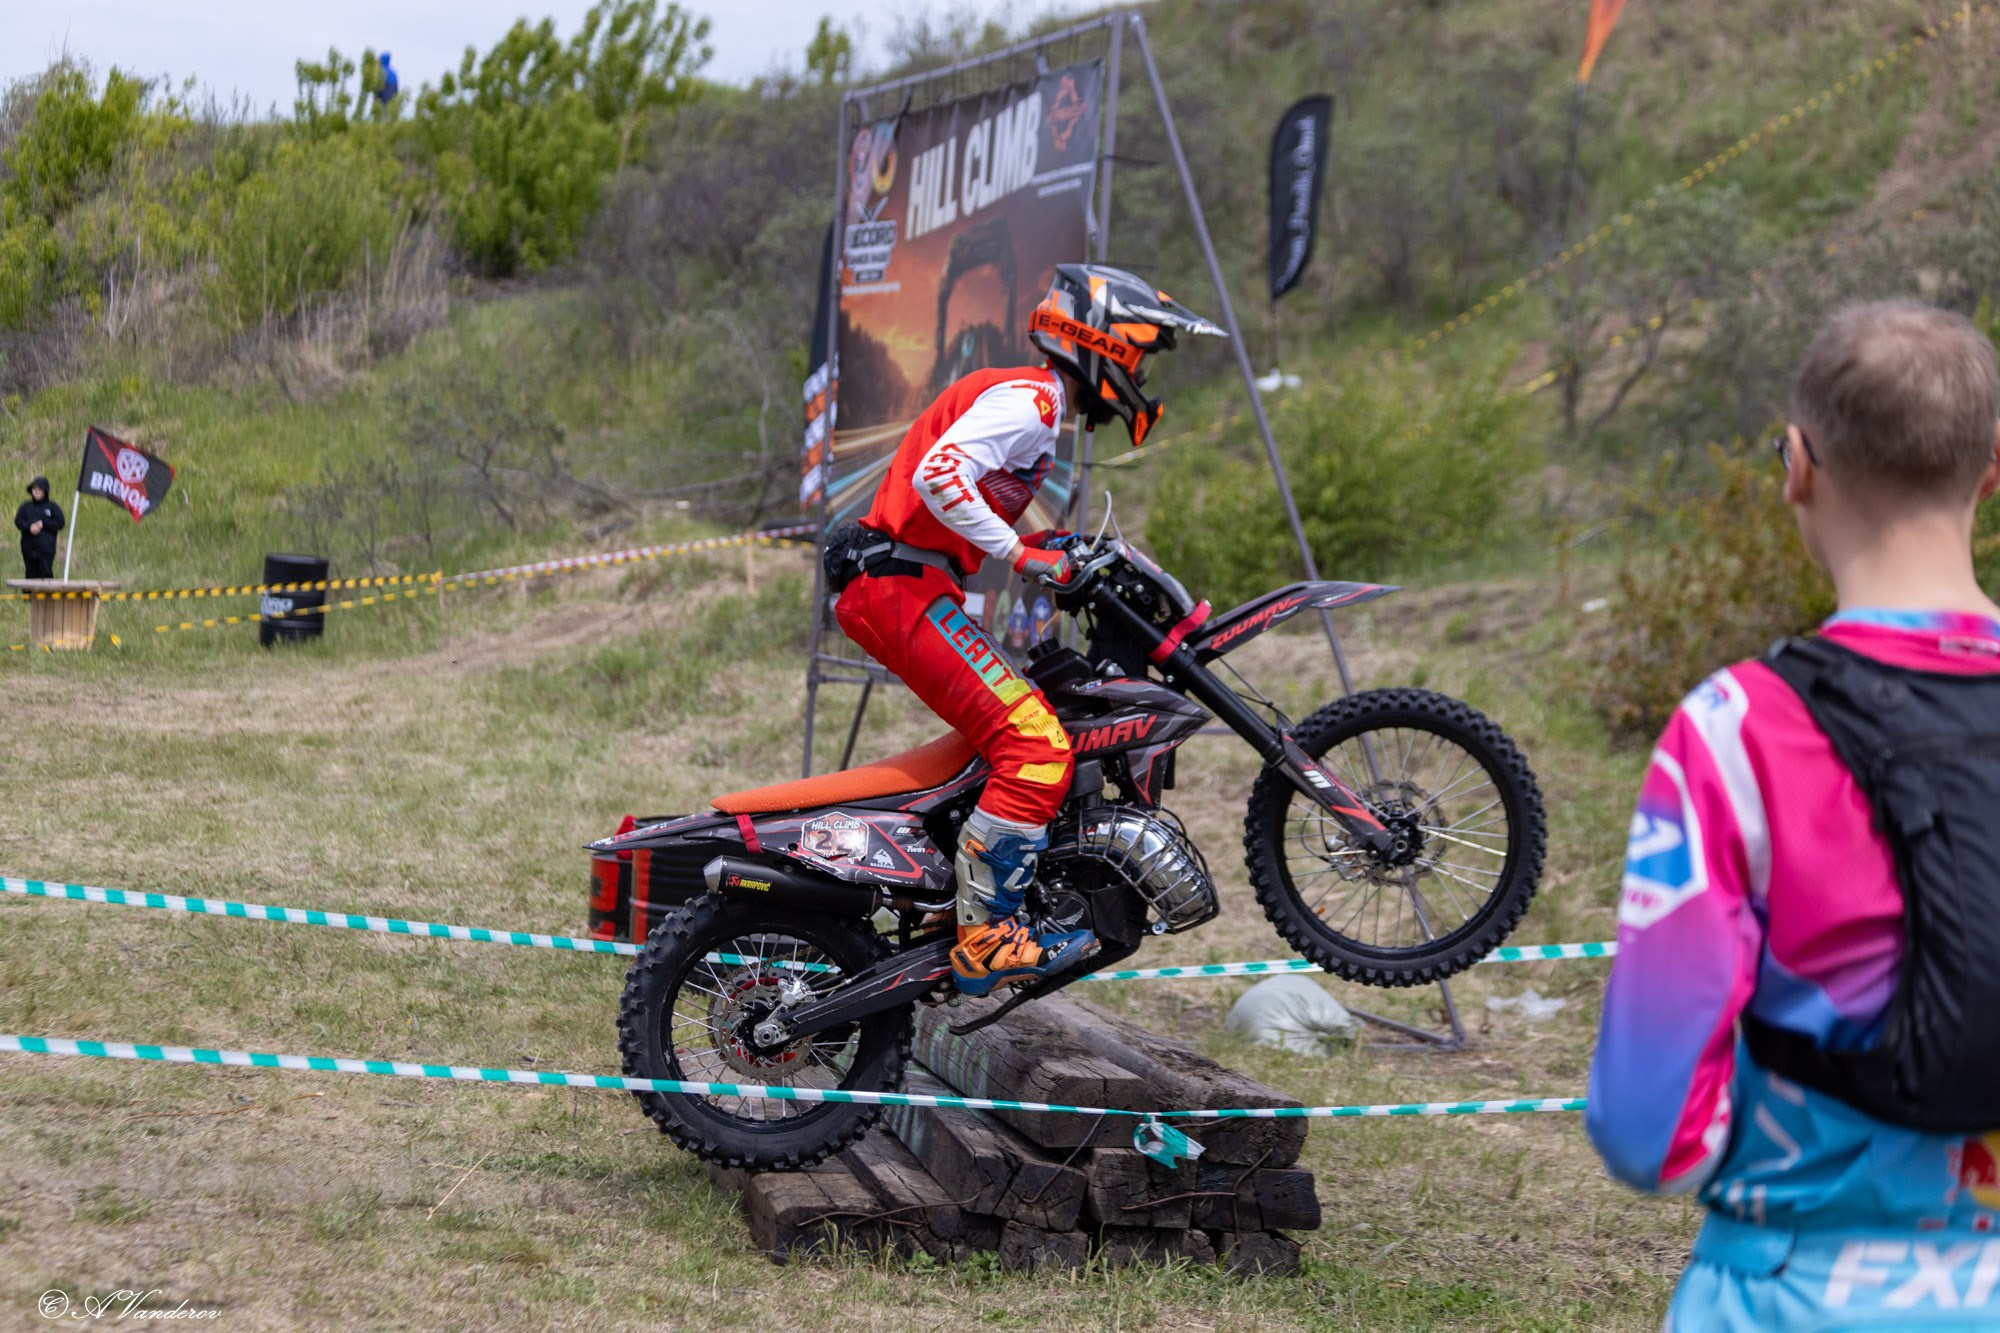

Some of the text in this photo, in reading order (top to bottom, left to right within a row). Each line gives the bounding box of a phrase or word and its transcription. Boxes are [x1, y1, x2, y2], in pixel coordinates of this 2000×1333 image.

[905, 91, 1042, 241] HILL CLIMB
[1039, 314, 1127, 359] E-GEAR
[938, 609, 1014, 687] LEATT
[1070, 714, 1158, 754] UMAV
[812, 820, 860, 830] HILL CLIMB
[906, 845, 926, 854] Twin
